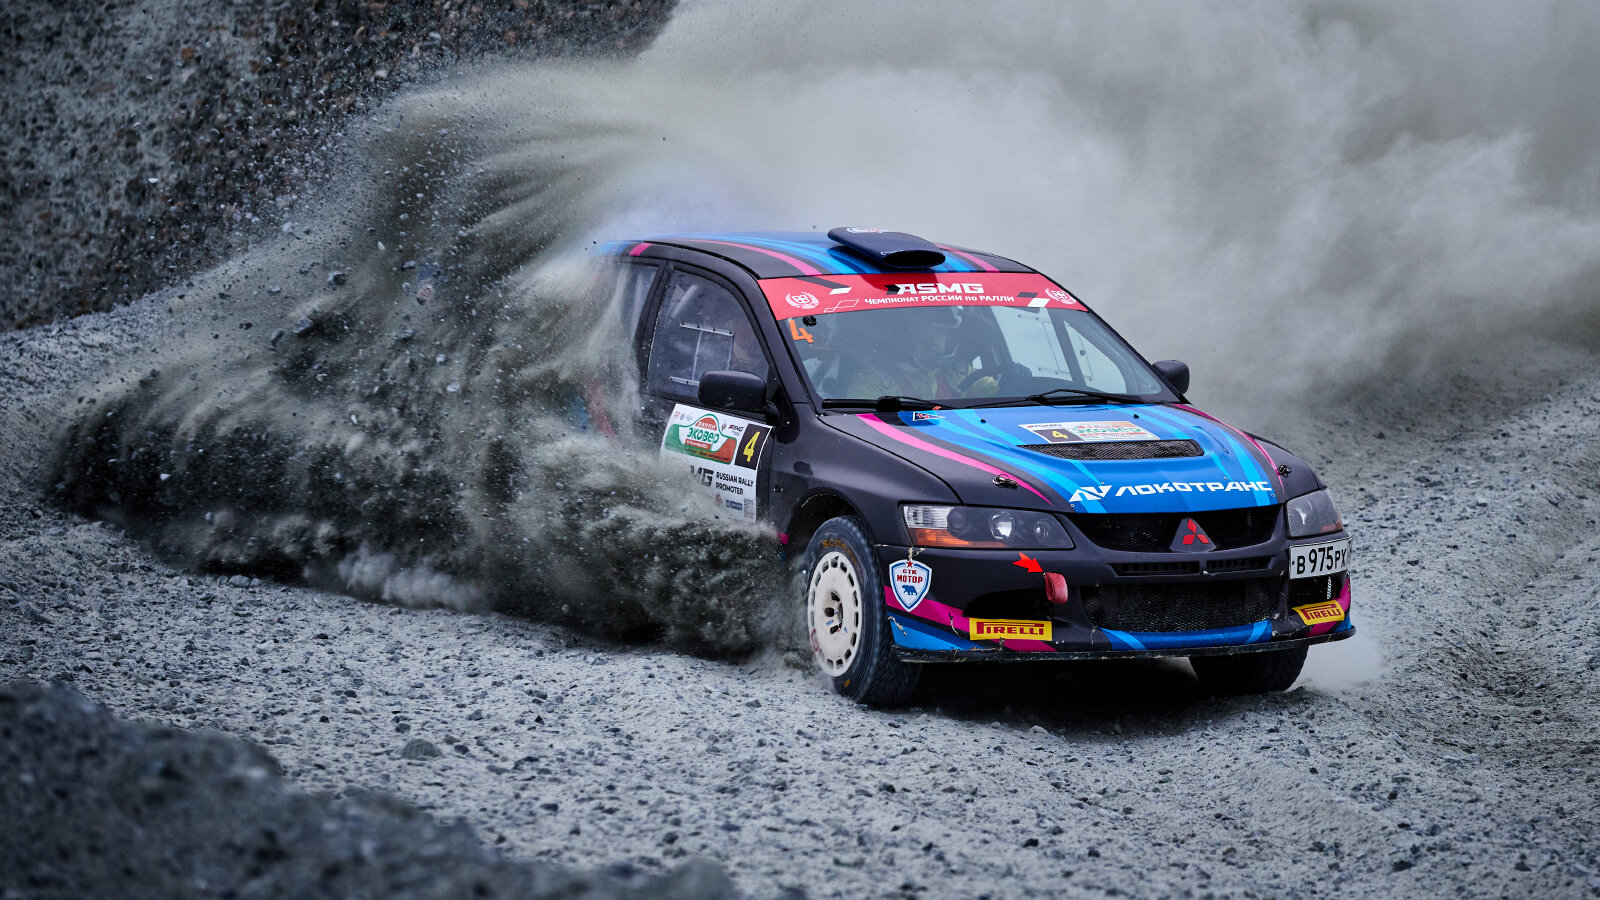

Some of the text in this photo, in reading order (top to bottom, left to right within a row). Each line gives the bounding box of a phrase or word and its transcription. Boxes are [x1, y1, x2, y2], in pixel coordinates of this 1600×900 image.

[895, 282, 985, 295] ASMG
[921, 294, 963, 302] РОССИИ
[789, 319, 814, 344] 4
[1052, 430, 1069, 439] 4
[743, 431, 760, 462] 4
[715, 471, 754, 487] RUSSIAN RALLY
[715, 482, 744, 495] PROMOTER
[1115, 481, 1273, 497] ЛОКОТРАНС
[896, 575, 923, 584] МОТОР
[1300, 603, 1342, 620] PIRELLI
[976, 621, 1045, 635] PIRELLI
